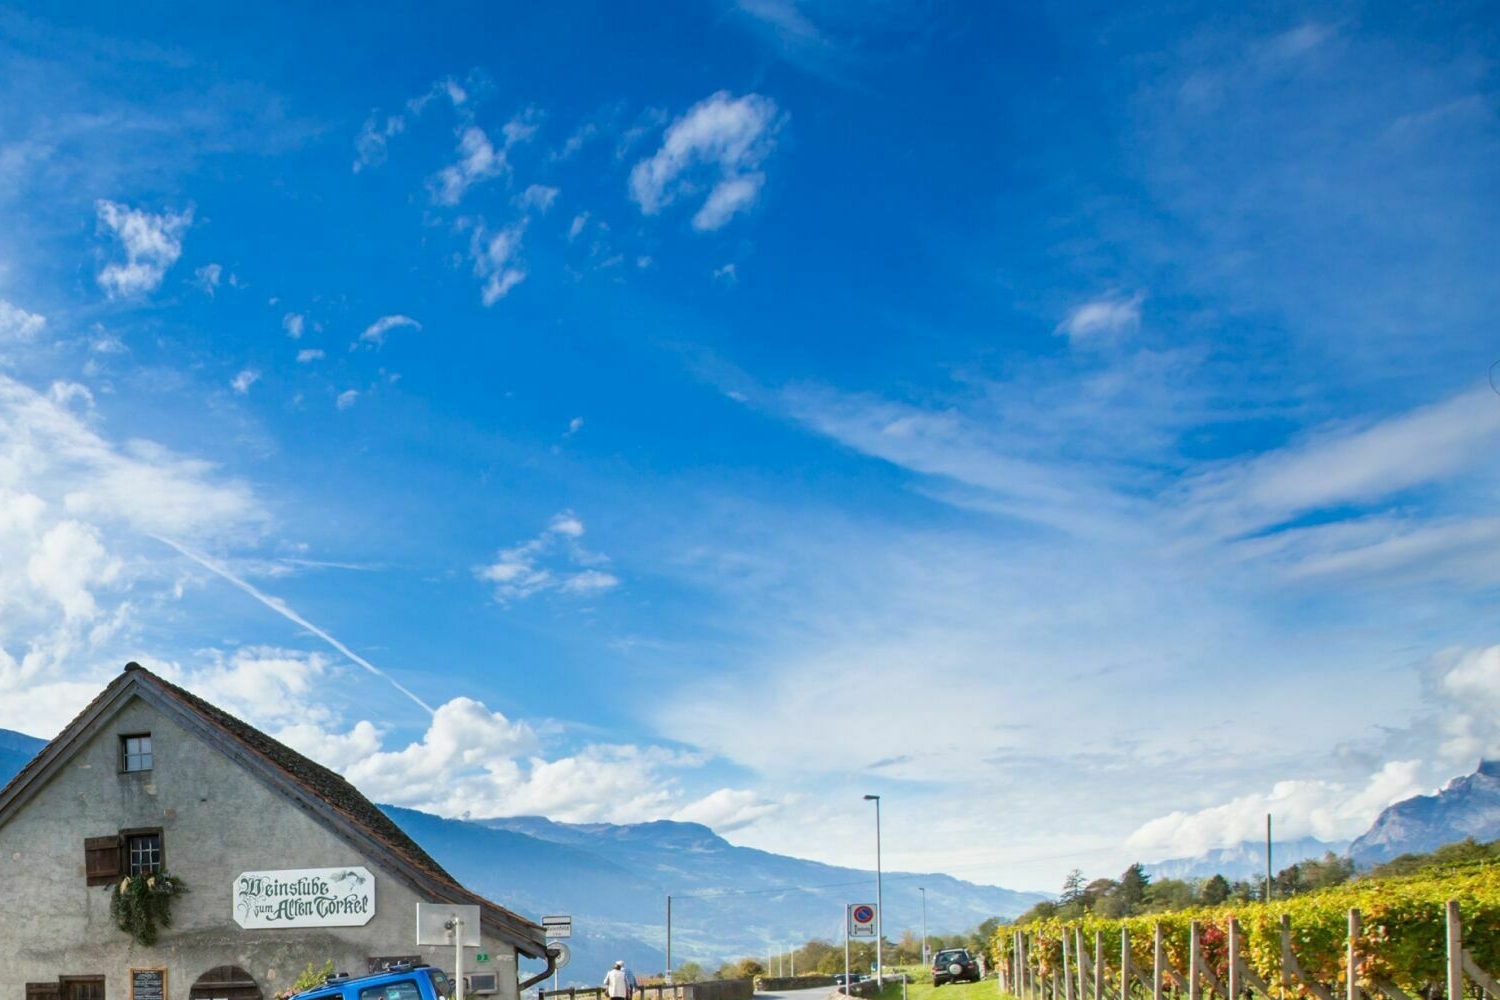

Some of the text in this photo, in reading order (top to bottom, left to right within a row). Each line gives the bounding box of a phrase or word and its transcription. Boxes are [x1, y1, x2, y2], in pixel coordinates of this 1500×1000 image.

[239, 876, 329, 897] Weinstube
[253, 893, 369, 921] zum Alten Torkel
